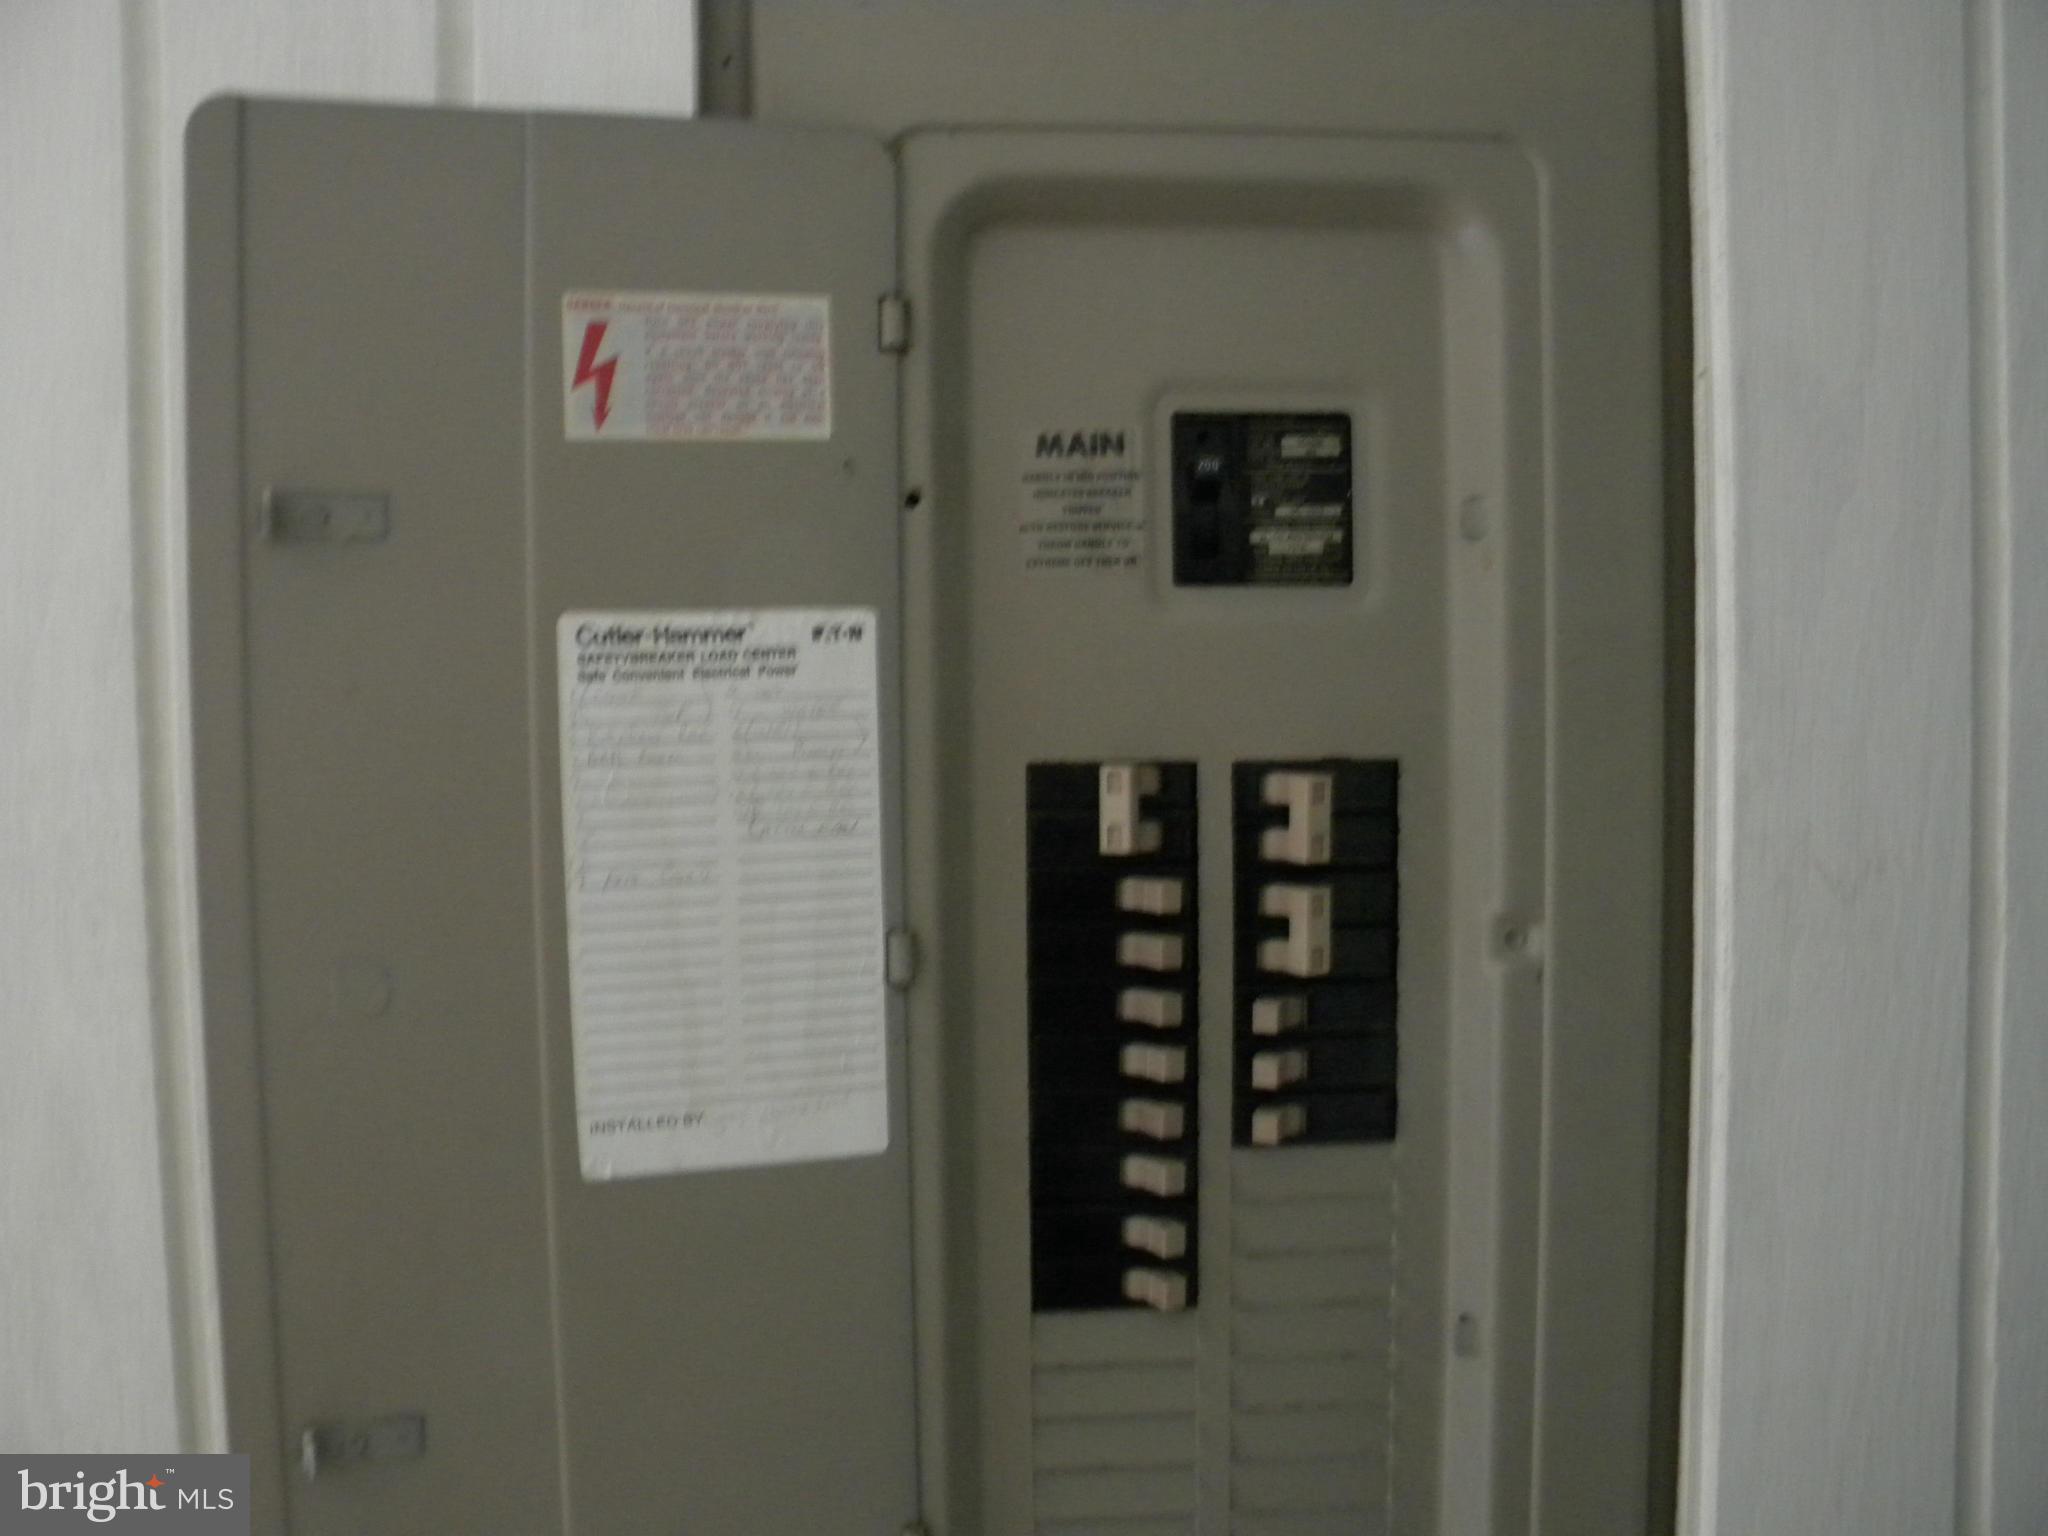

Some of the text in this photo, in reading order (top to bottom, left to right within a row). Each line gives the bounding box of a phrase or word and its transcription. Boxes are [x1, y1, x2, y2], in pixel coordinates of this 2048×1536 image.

[1035, 431, 1126, 458] MAIN
[700, 647, 739, 664] LOAD
[743, 645, 797, 662] CENTER
[576, 664, 798, 685] Safe Convenient Electrical Power
[590, 1109, 705, 1136] INSTALLED BY
